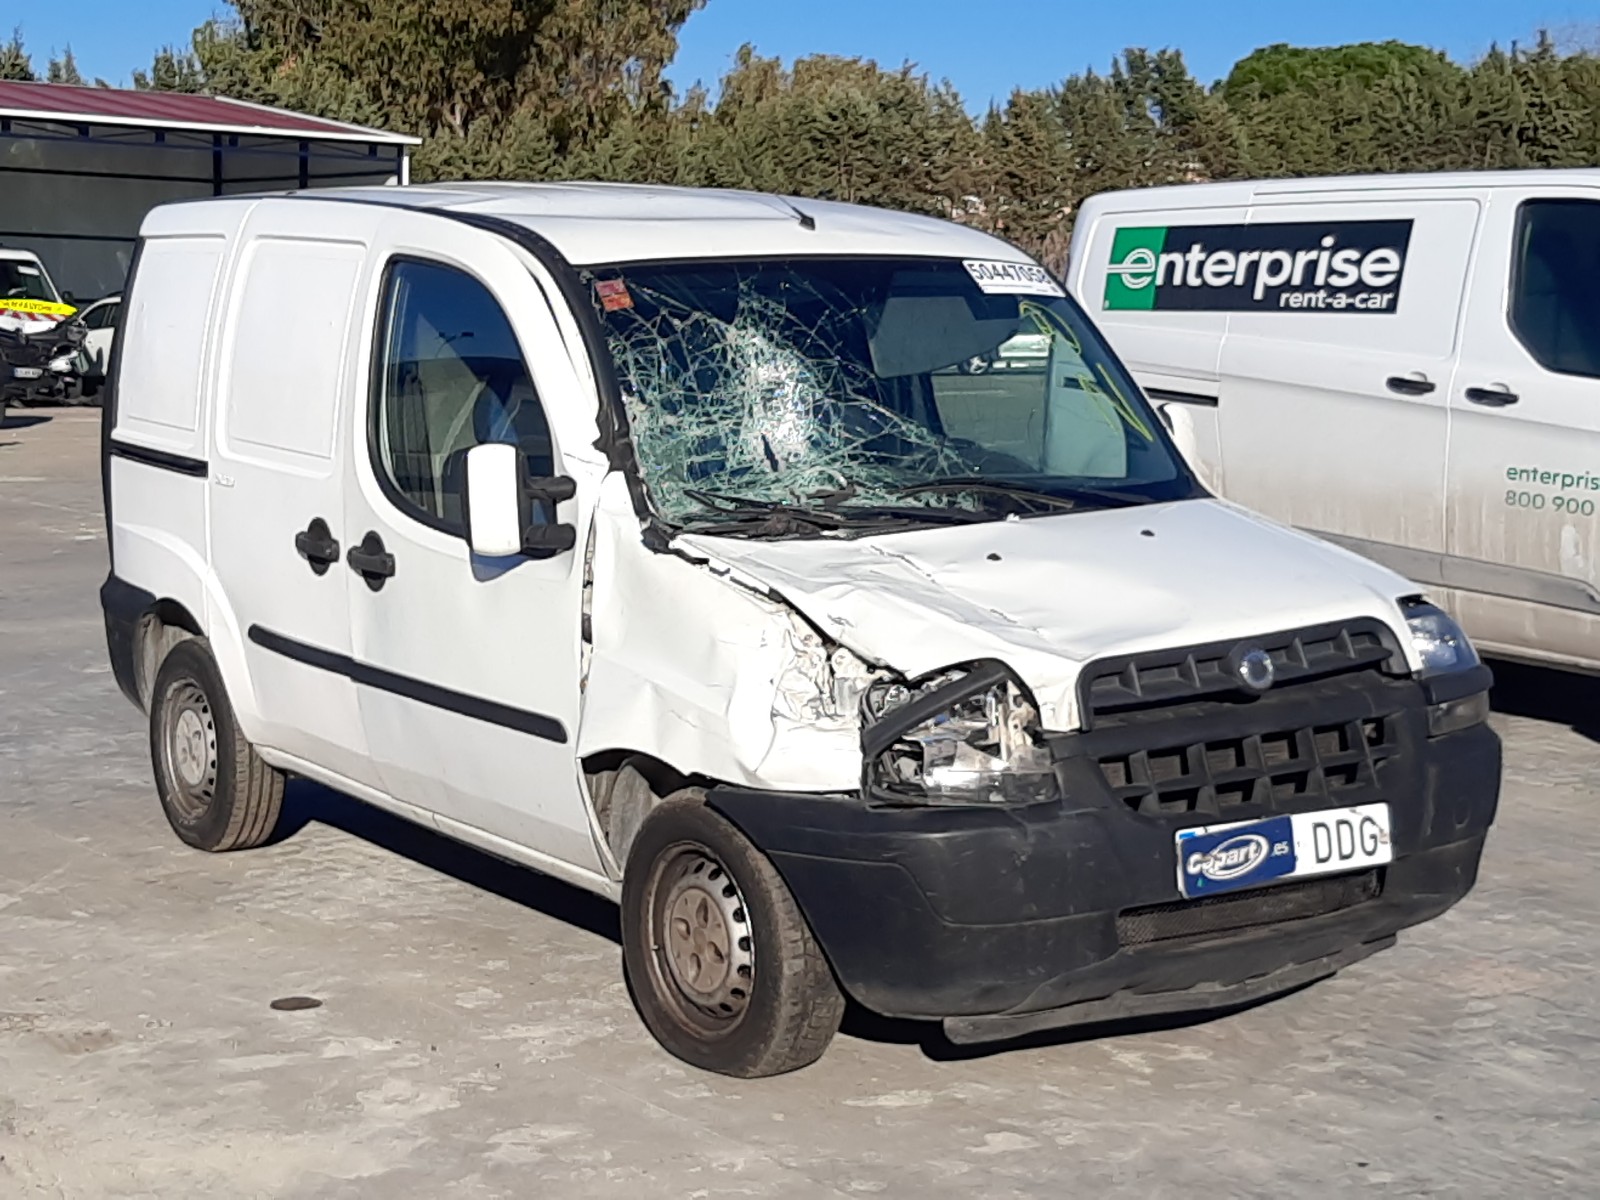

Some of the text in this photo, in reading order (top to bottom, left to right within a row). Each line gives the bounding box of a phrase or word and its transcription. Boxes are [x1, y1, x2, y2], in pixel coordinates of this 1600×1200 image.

[1107, 235, 1400, 300] enterprise
[1279, 289, 1395, 309] rent-a-car
[1505, 489, 1595, 517] 800 900
[1312, 815, 1378, 864] DDG
